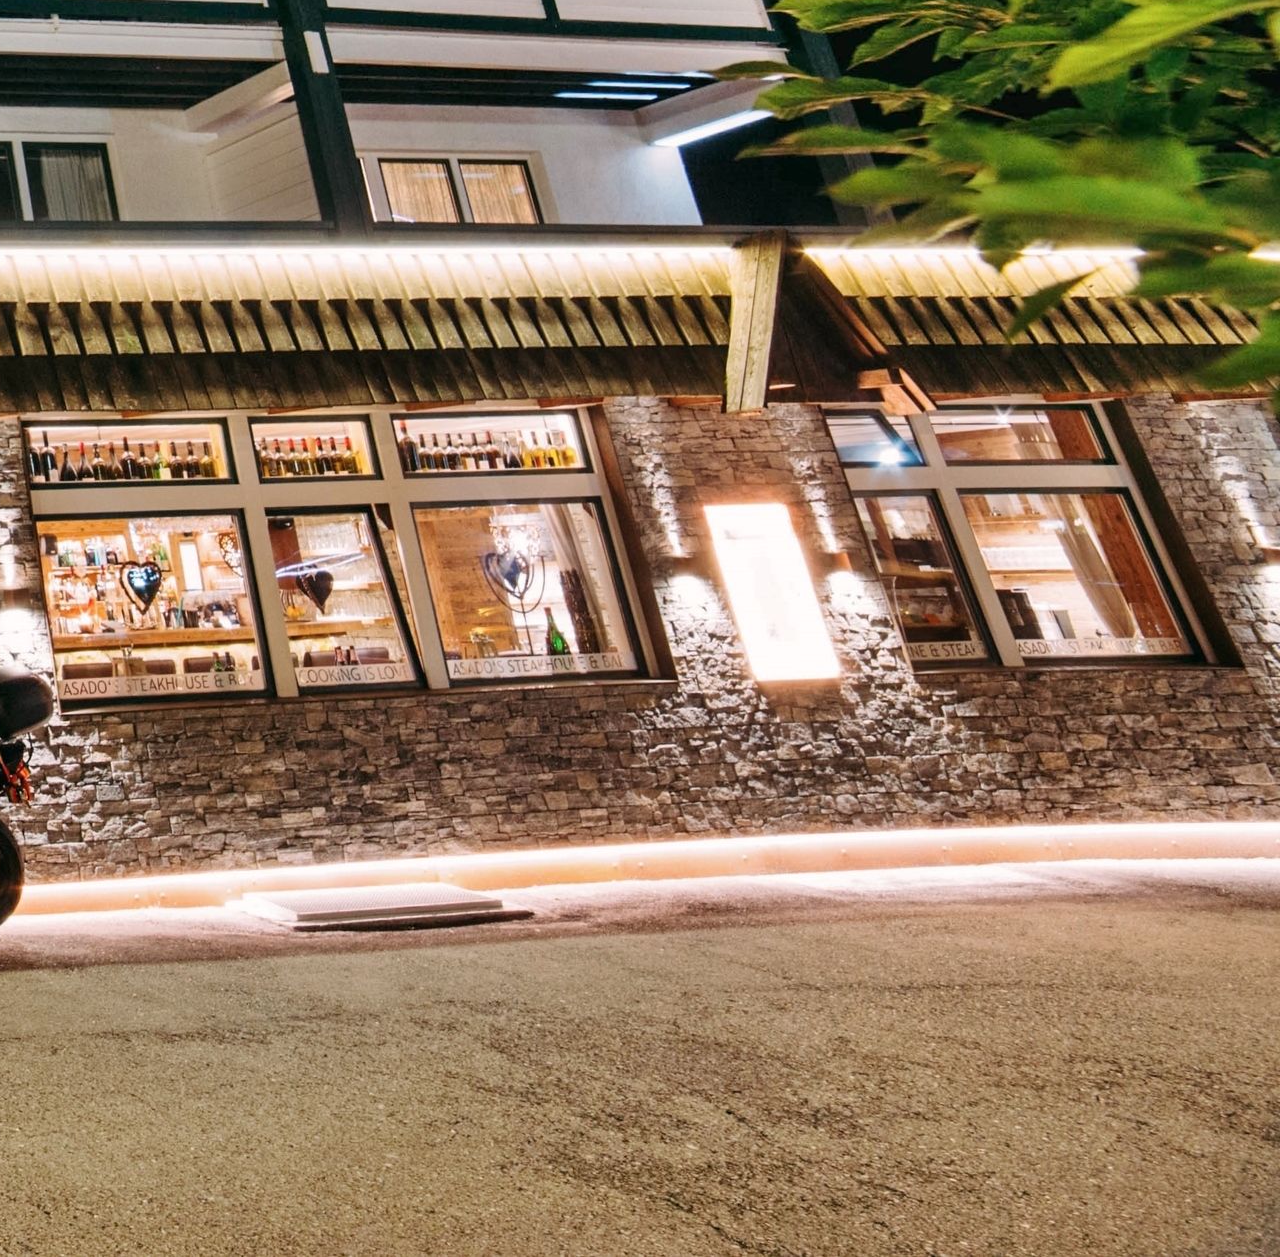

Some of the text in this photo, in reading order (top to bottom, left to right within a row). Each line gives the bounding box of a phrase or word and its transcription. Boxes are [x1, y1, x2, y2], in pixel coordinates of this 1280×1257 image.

[929, 644, 941, 658] &
[452, 657, 506, 675] ASADO'S
[590, 655, 600, 670] &
[213, 673, 225, 689] &
[299, 667, 361, 684] COOKING
[363, 666, 376, 682] IS
